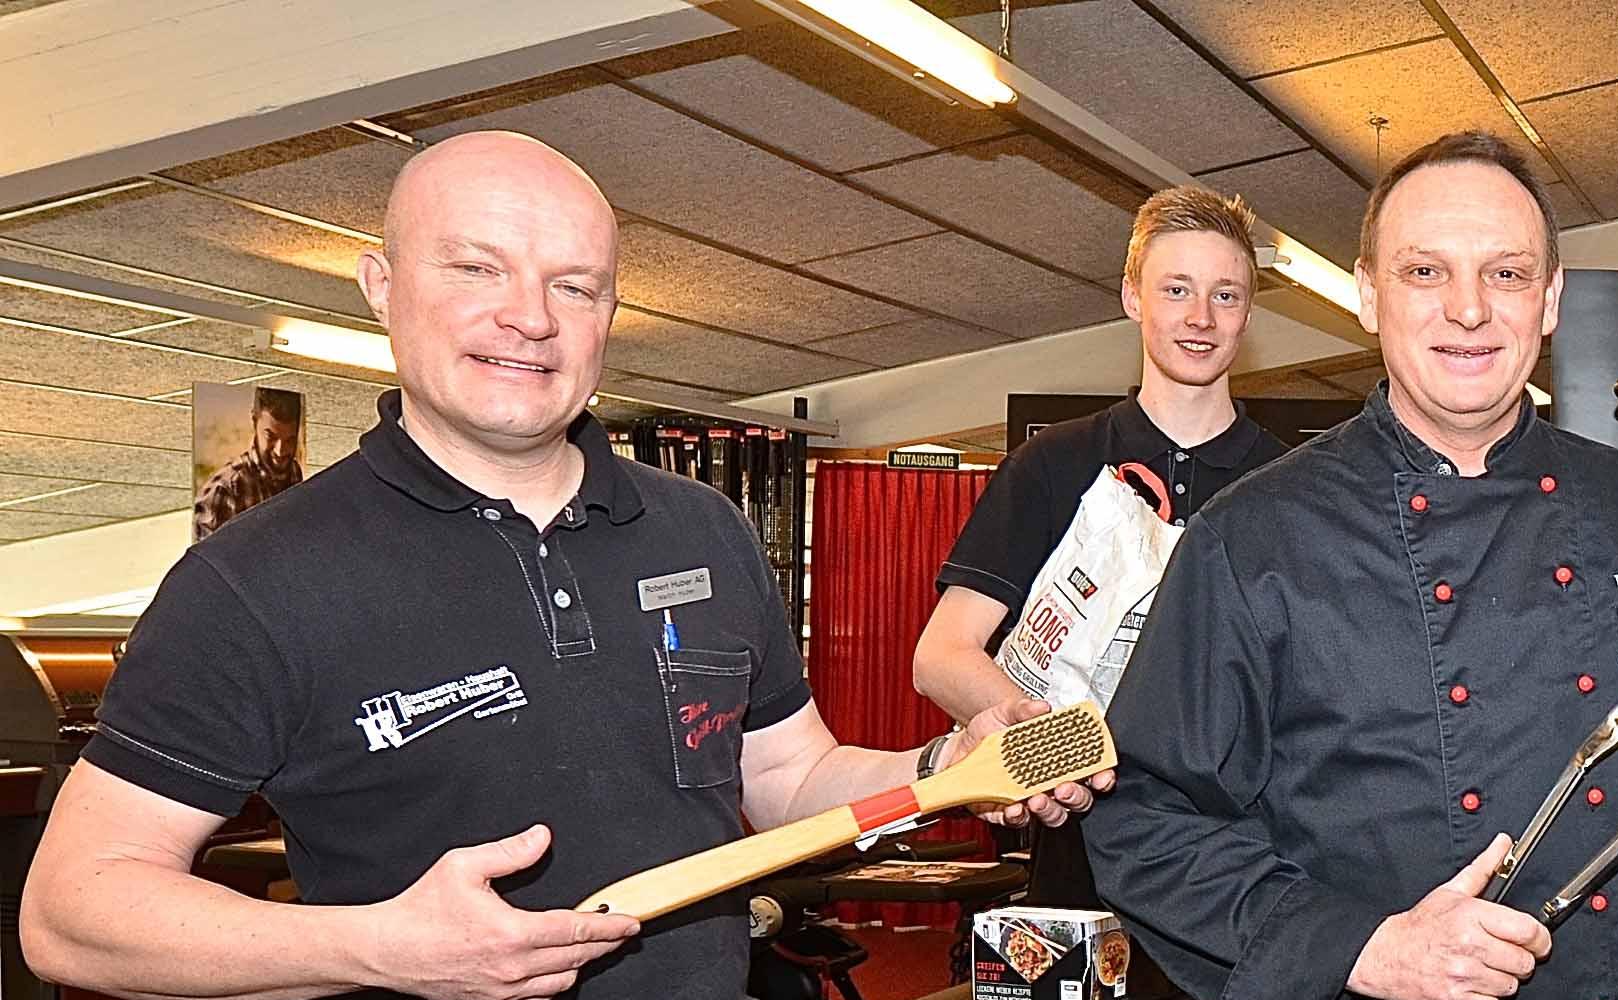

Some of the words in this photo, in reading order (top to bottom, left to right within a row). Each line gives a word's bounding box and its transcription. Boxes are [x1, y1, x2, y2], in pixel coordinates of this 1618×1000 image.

[893, 454, 954, 467] NOTAUSGANG
[645, 584, 670, 593] Robert
[1026, 598, 1068, 653] LONG
[404, 692, 459, 717] Robert
[460, 679, 505, 699] Huber
